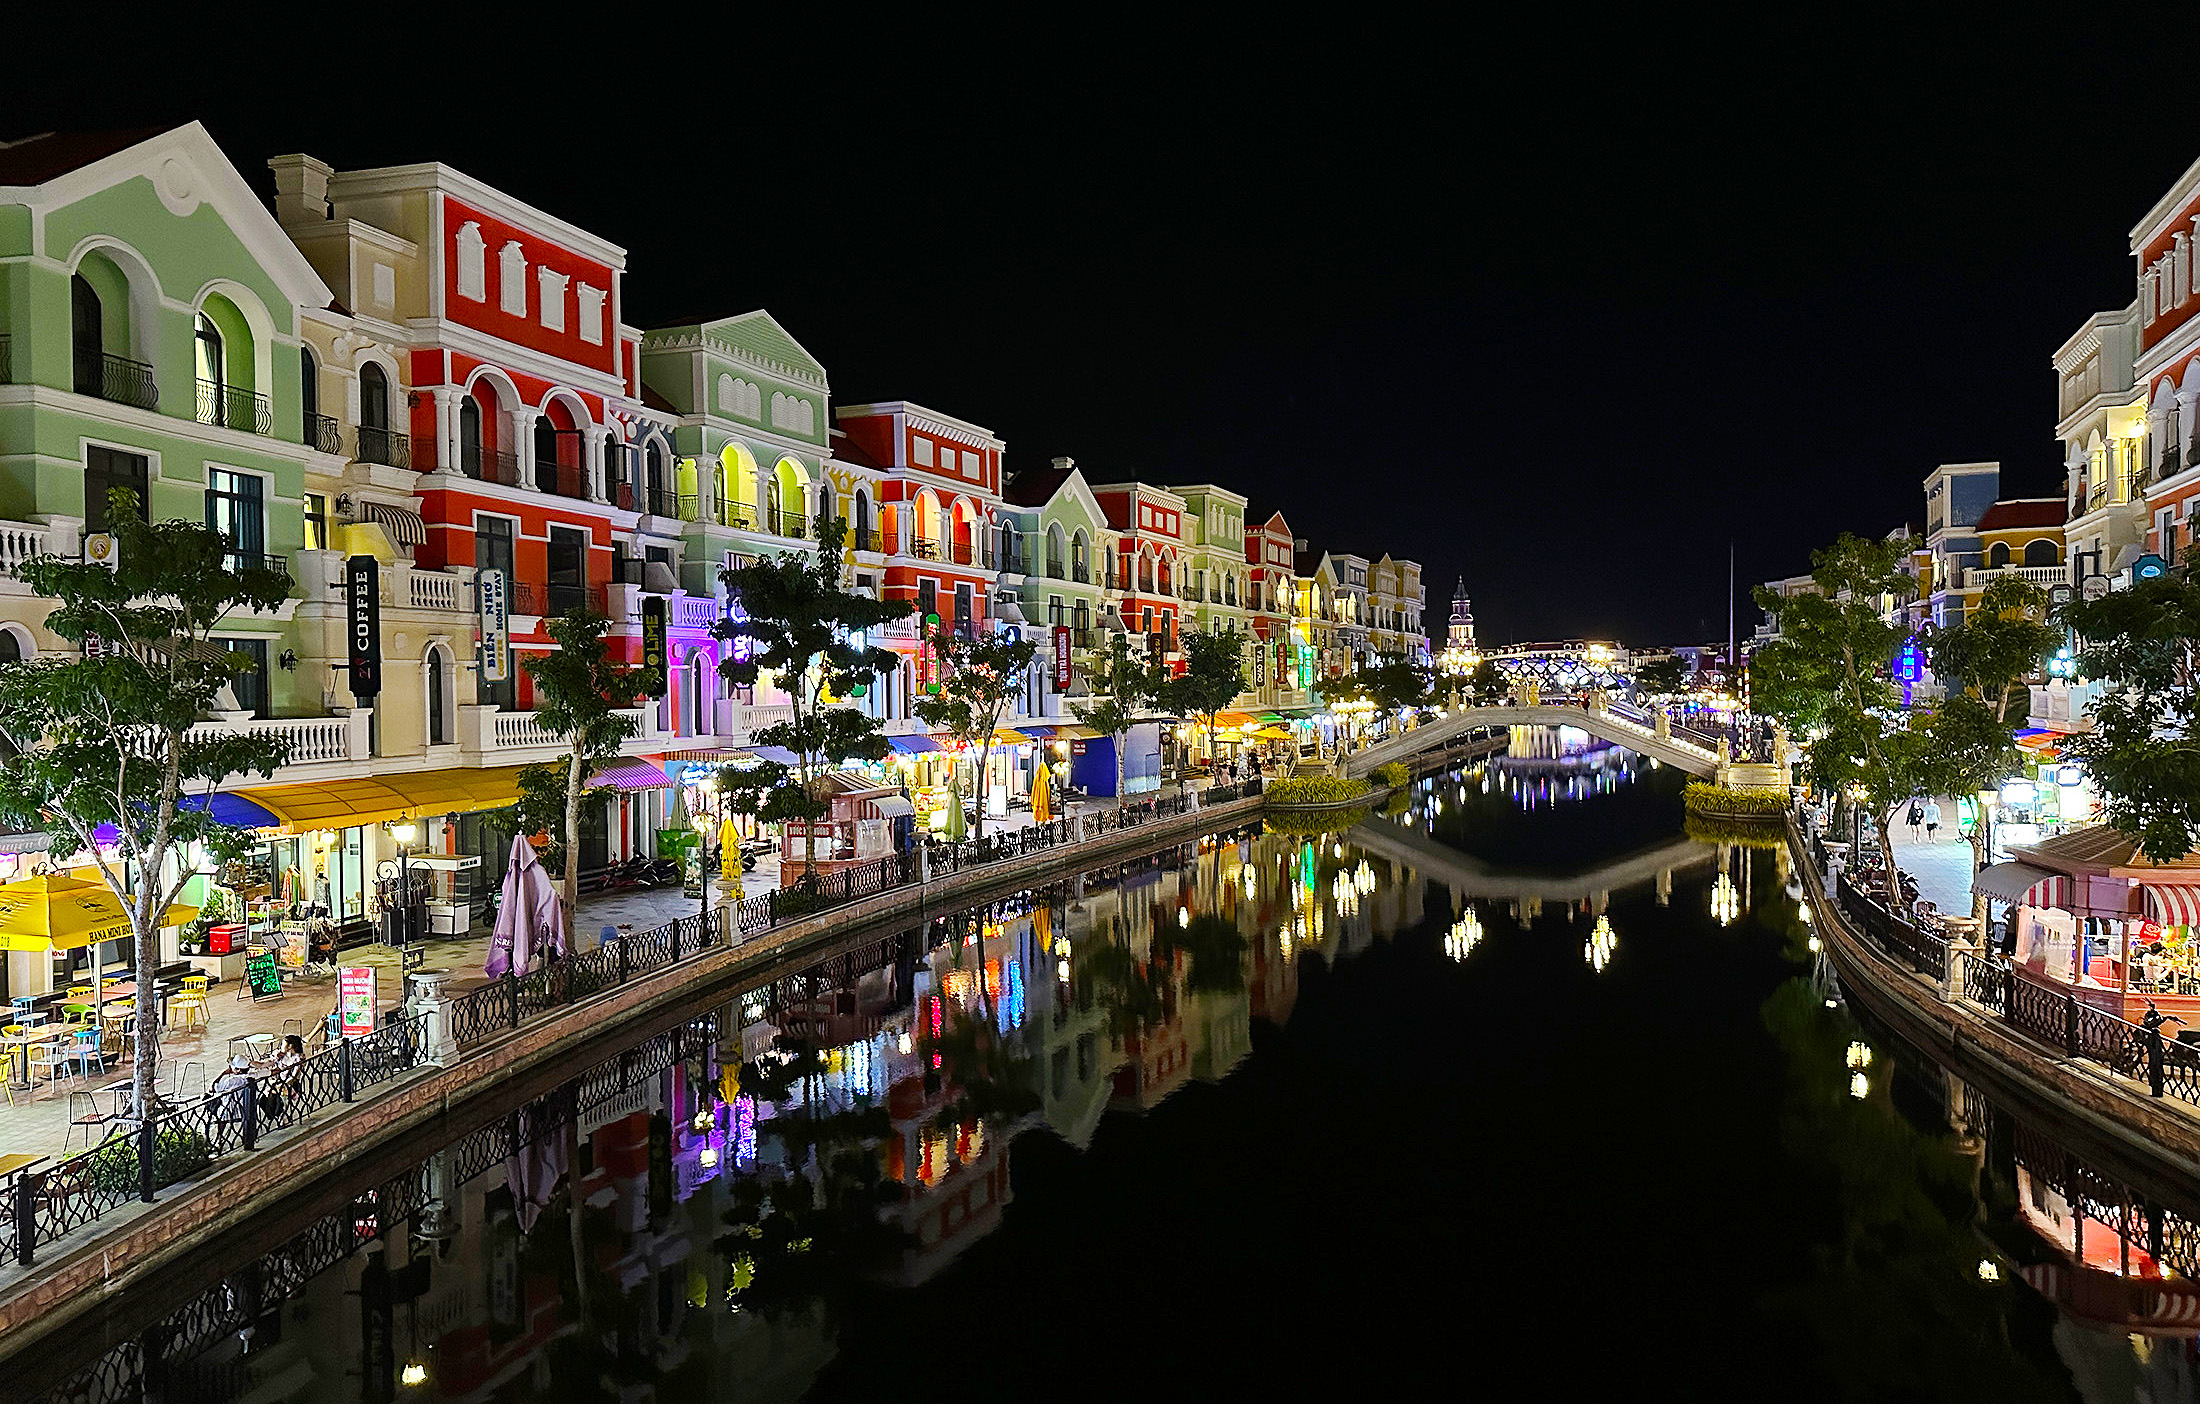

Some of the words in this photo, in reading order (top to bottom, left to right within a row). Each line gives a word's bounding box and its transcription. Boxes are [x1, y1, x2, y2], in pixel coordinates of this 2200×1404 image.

[494, 571, 502, 598] STAY
[356, 571, 369, 651] COFFEE
[88, 929, 107, 942] HANA
